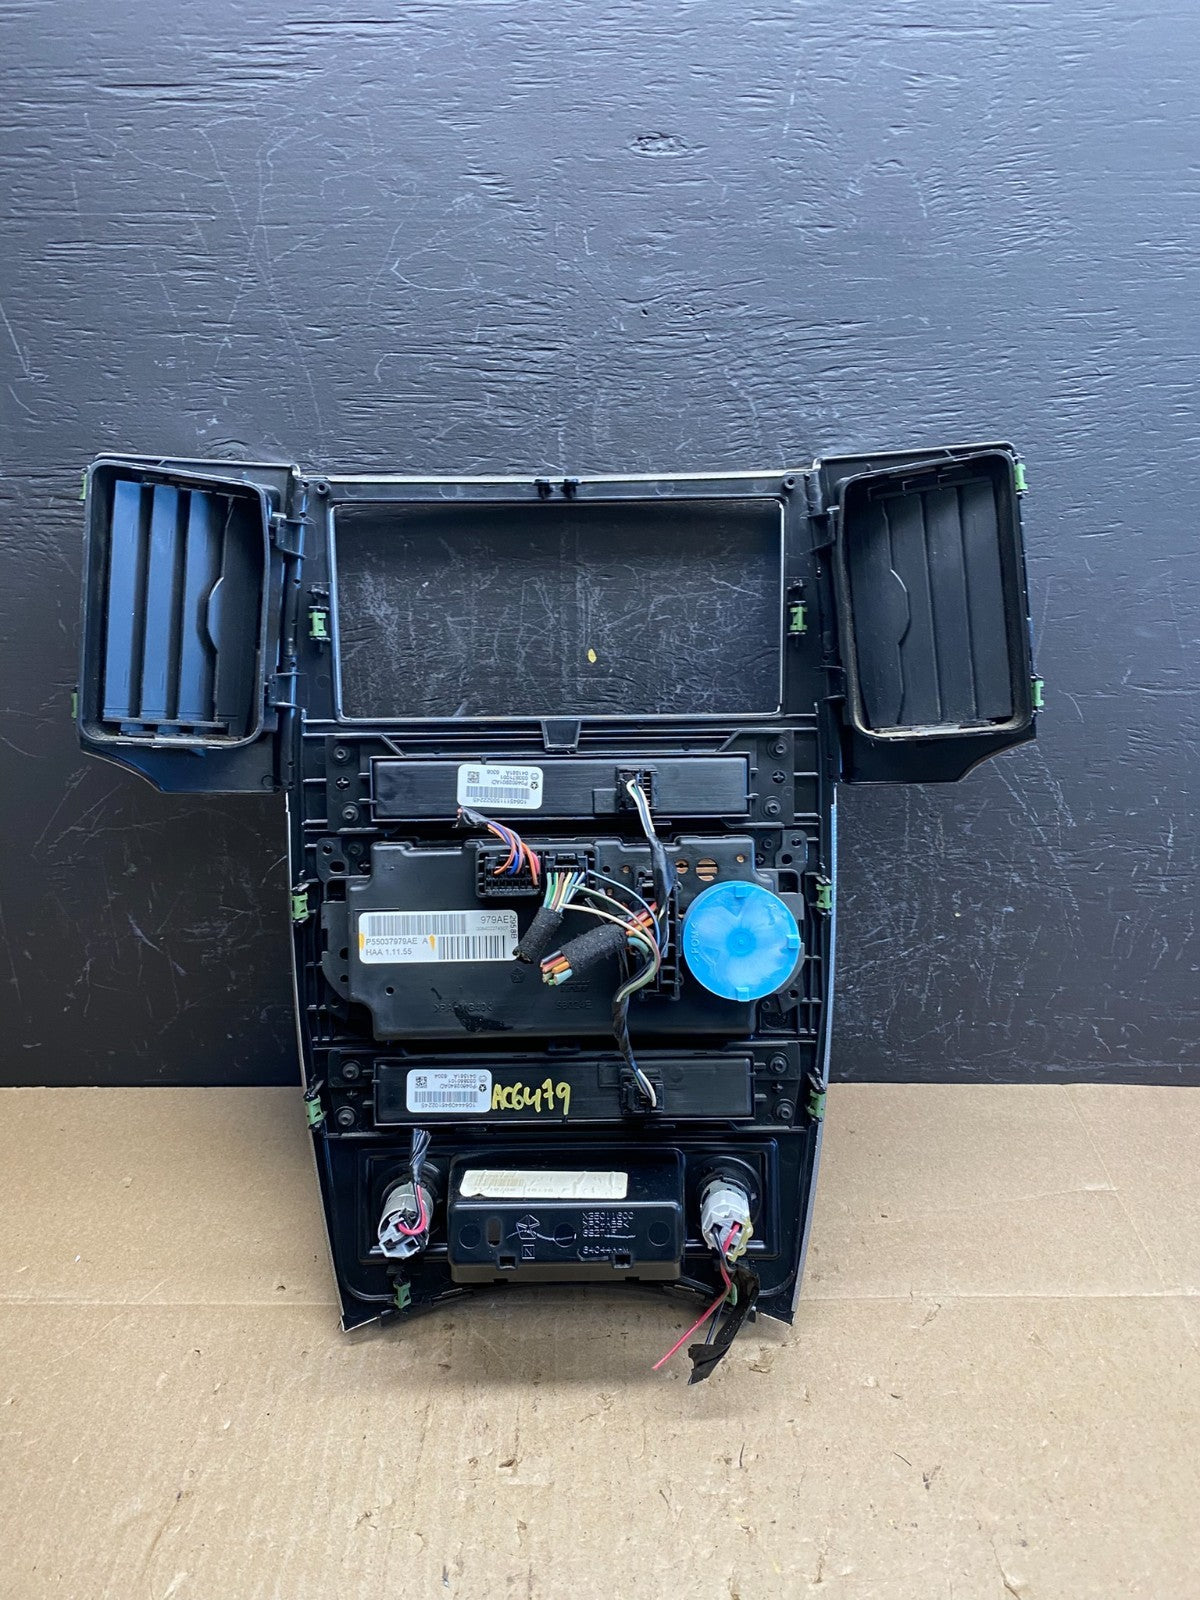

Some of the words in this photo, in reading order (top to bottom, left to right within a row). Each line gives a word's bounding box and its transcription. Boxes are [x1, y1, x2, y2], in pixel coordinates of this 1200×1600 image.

[480, 914, 509, 924] 979AE
[365, 937, 418, 946] P55037979AE
[422, 937, 429, 945] A
[365, 948, 383, 956] HAA
[491, 1078, 571, 1116] AC6479
